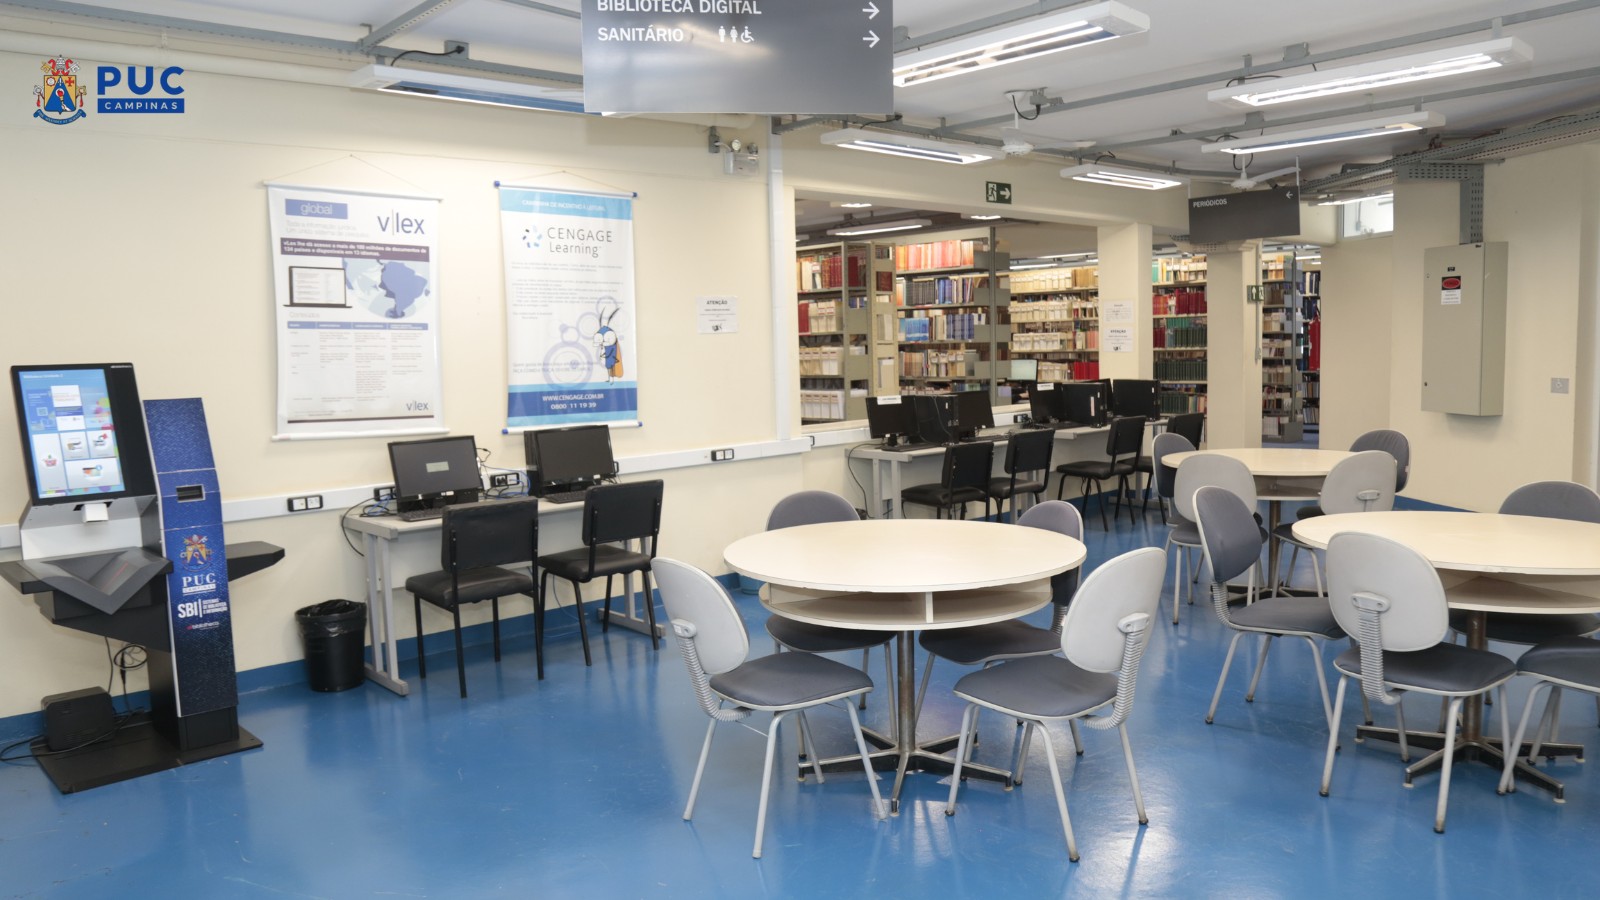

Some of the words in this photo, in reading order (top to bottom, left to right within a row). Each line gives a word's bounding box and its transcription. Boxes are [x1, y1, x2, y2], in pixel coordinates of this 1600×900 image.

[597, 0, 694, 13] BIBLIOTECA
[700, 0, 762, 14] DIGITAL
[598, 25, 684, 42] SANITÁRIO
[301, 203, 333, 216] global
[547, 227, 613, 243] CENGAGE
[550, 242, 599, 258] Learning
[542, 393, 604, 401] WWW.CENGAGE.COM.BR
[182, 573, 216, 587] PUC
[177, 601, 199, 618] SBI
